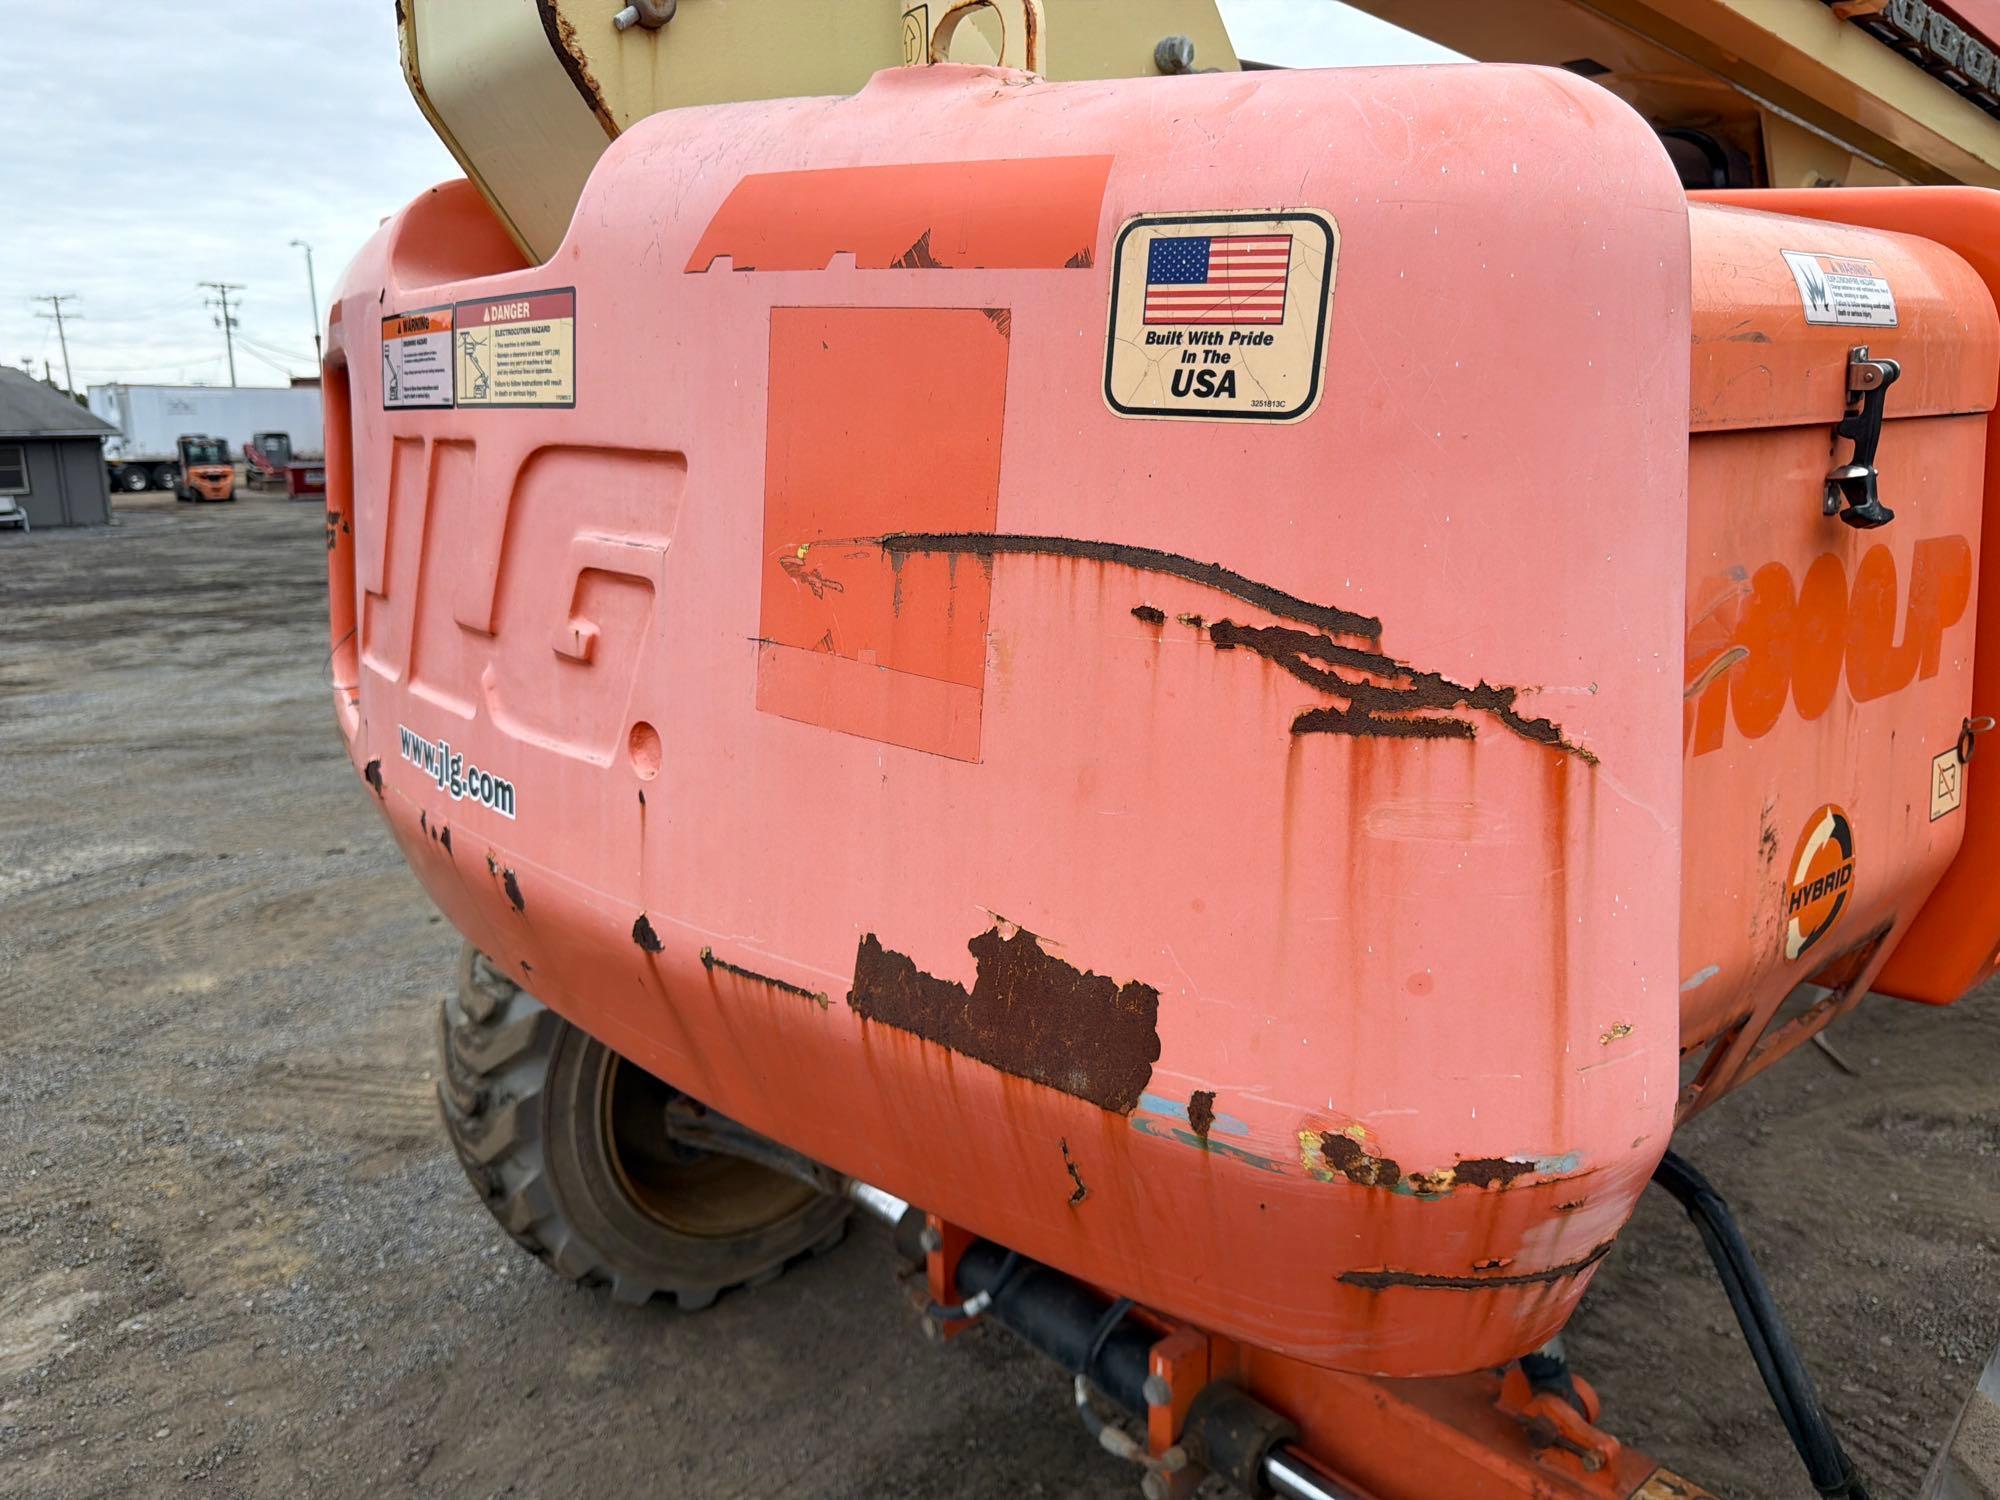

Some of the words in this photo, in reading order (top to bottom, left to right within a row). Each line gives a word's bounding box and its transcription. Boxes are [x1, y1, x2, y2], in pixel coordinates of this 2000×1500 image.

[491, 302, 530, 321] DANGER
[402, 316, 430, 333] WARNING
[495, 327, 530, 338] ELECTROCUTION
[531, 325, 551, 334] HAZARD
[1145, 331, 1183, 346] Built
[1188, 331, 1224, 346] With
[1228, 331, 1274, 346] Pride
[1181, 350, 1197, 364] In
[1202, 350, 1231, 364] The
[1170, 368, 1237, 399] USA
[1250, 400, 1286, 408] 3251813C
[362, 435, 688, 769] JLG
[399, 725, 516, 818] www.jlg.com
[1788, 863, 1853, 914] HYBRID
